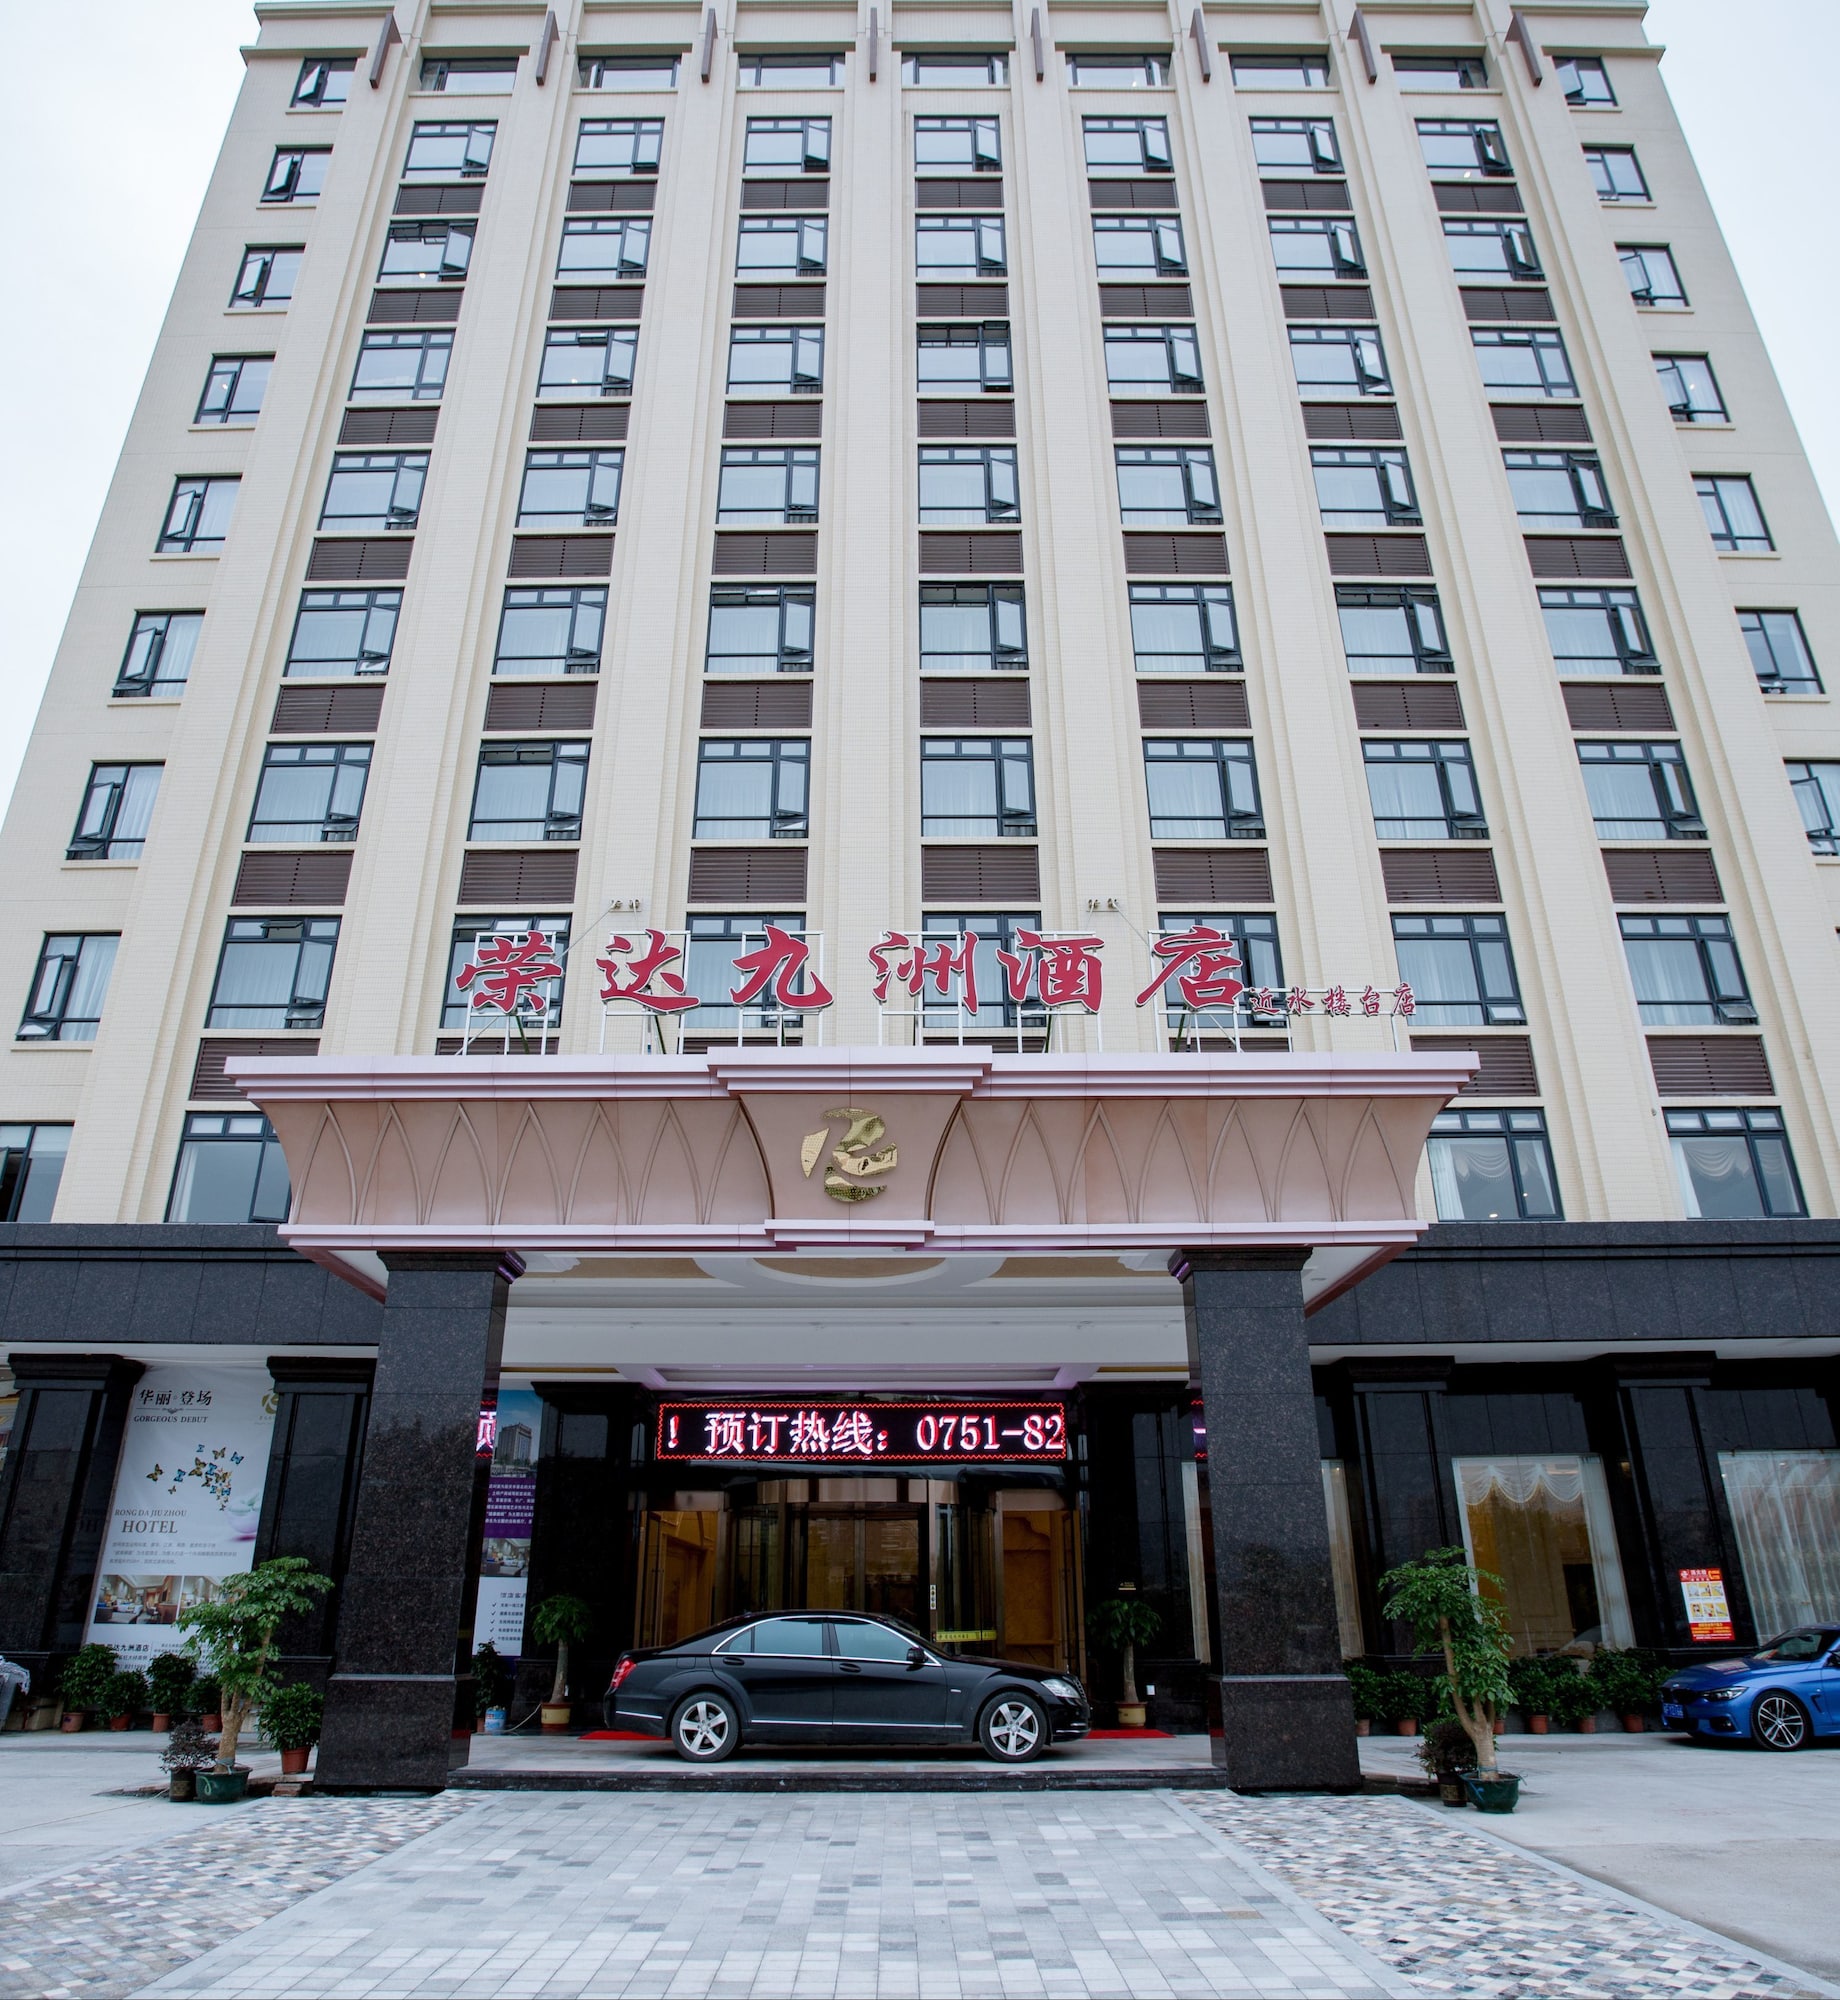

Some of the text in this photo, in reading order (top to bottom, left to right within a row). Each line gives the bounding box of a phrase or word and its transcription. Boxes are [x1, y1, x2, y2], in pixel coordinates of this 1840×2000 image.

[455, 924, 1243, 1015] 荣达九洲酒店
[1249, 982, 1417, 1016] 近水楼台店
[134, 1415, 208, 1423] GORGEOUS DEBUT
[916, 1415, 1065, 1451] 0751-82
[121, 1520, 178, 1533] HOTEL
